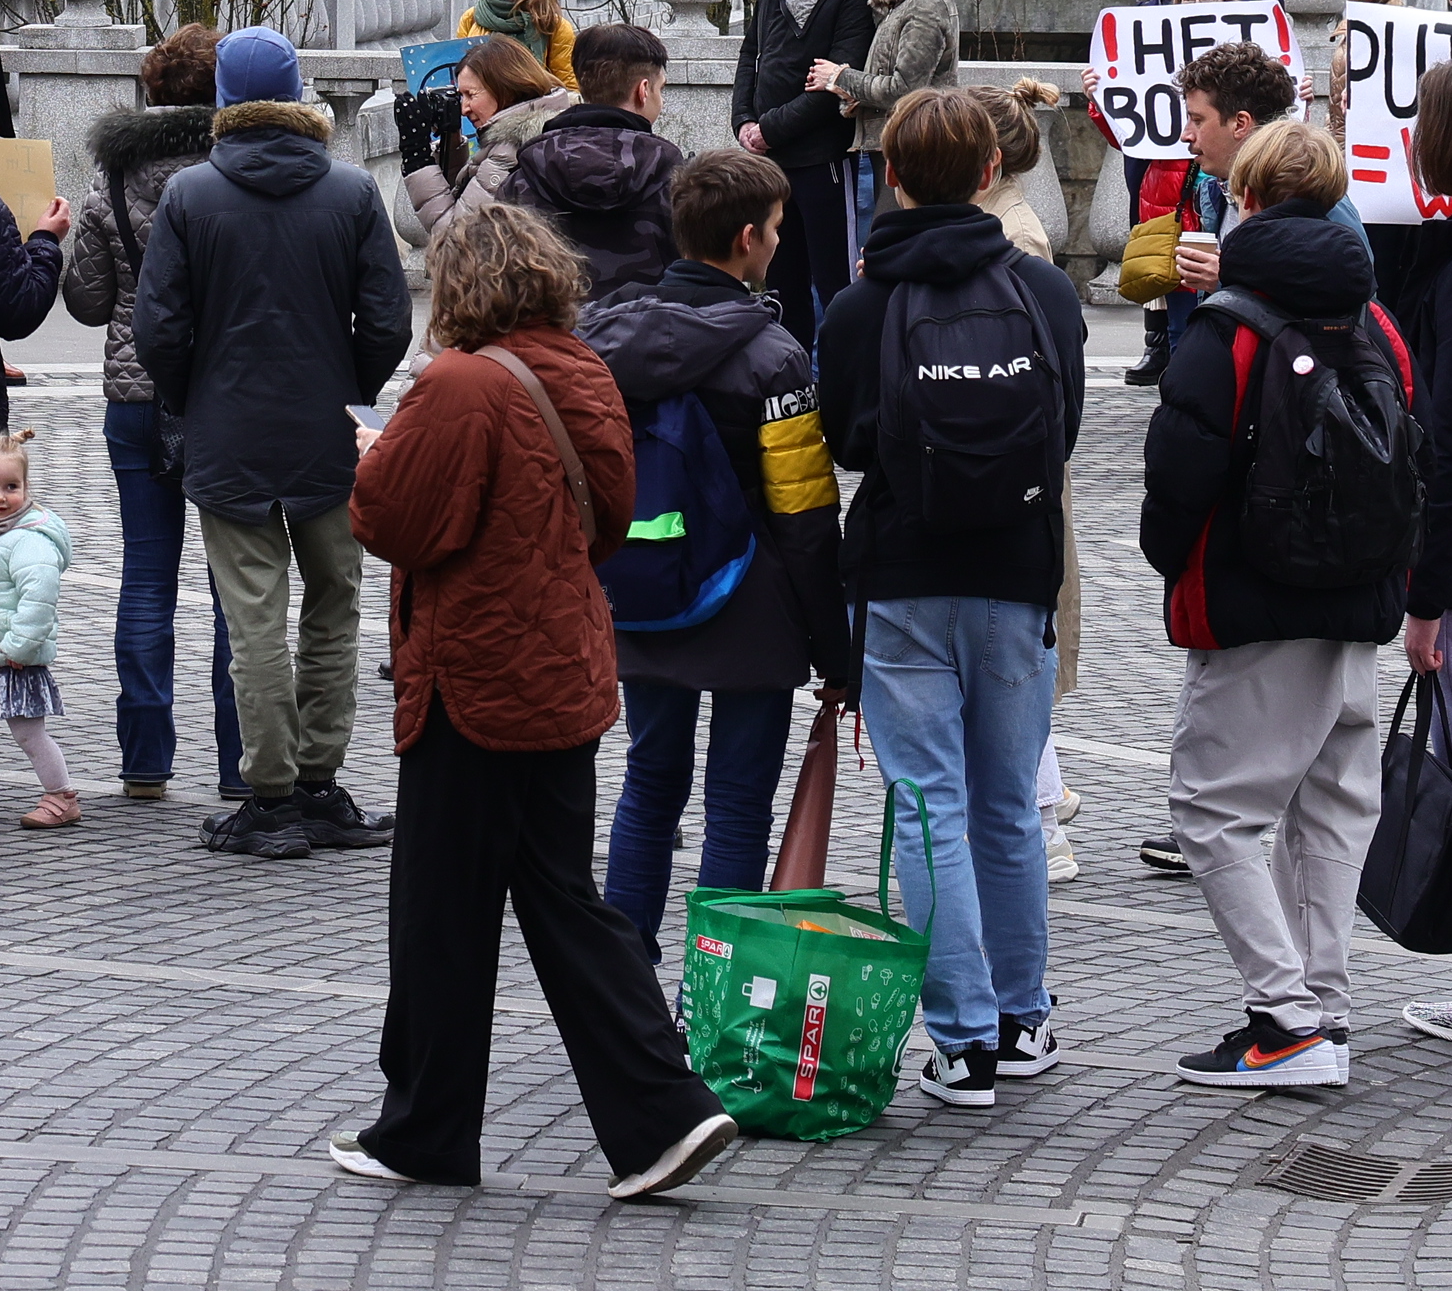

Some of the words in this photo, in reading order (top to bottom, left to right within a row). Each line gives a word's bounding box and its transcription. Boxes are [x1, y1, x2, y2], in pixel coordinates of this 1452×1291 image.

[918, 365, 981, 380] NIKE
[988, 356, 1032, 379] AIR
[701, 939, 723, 953] SPAR
[800, 1007, 822, 1079] SPAR
